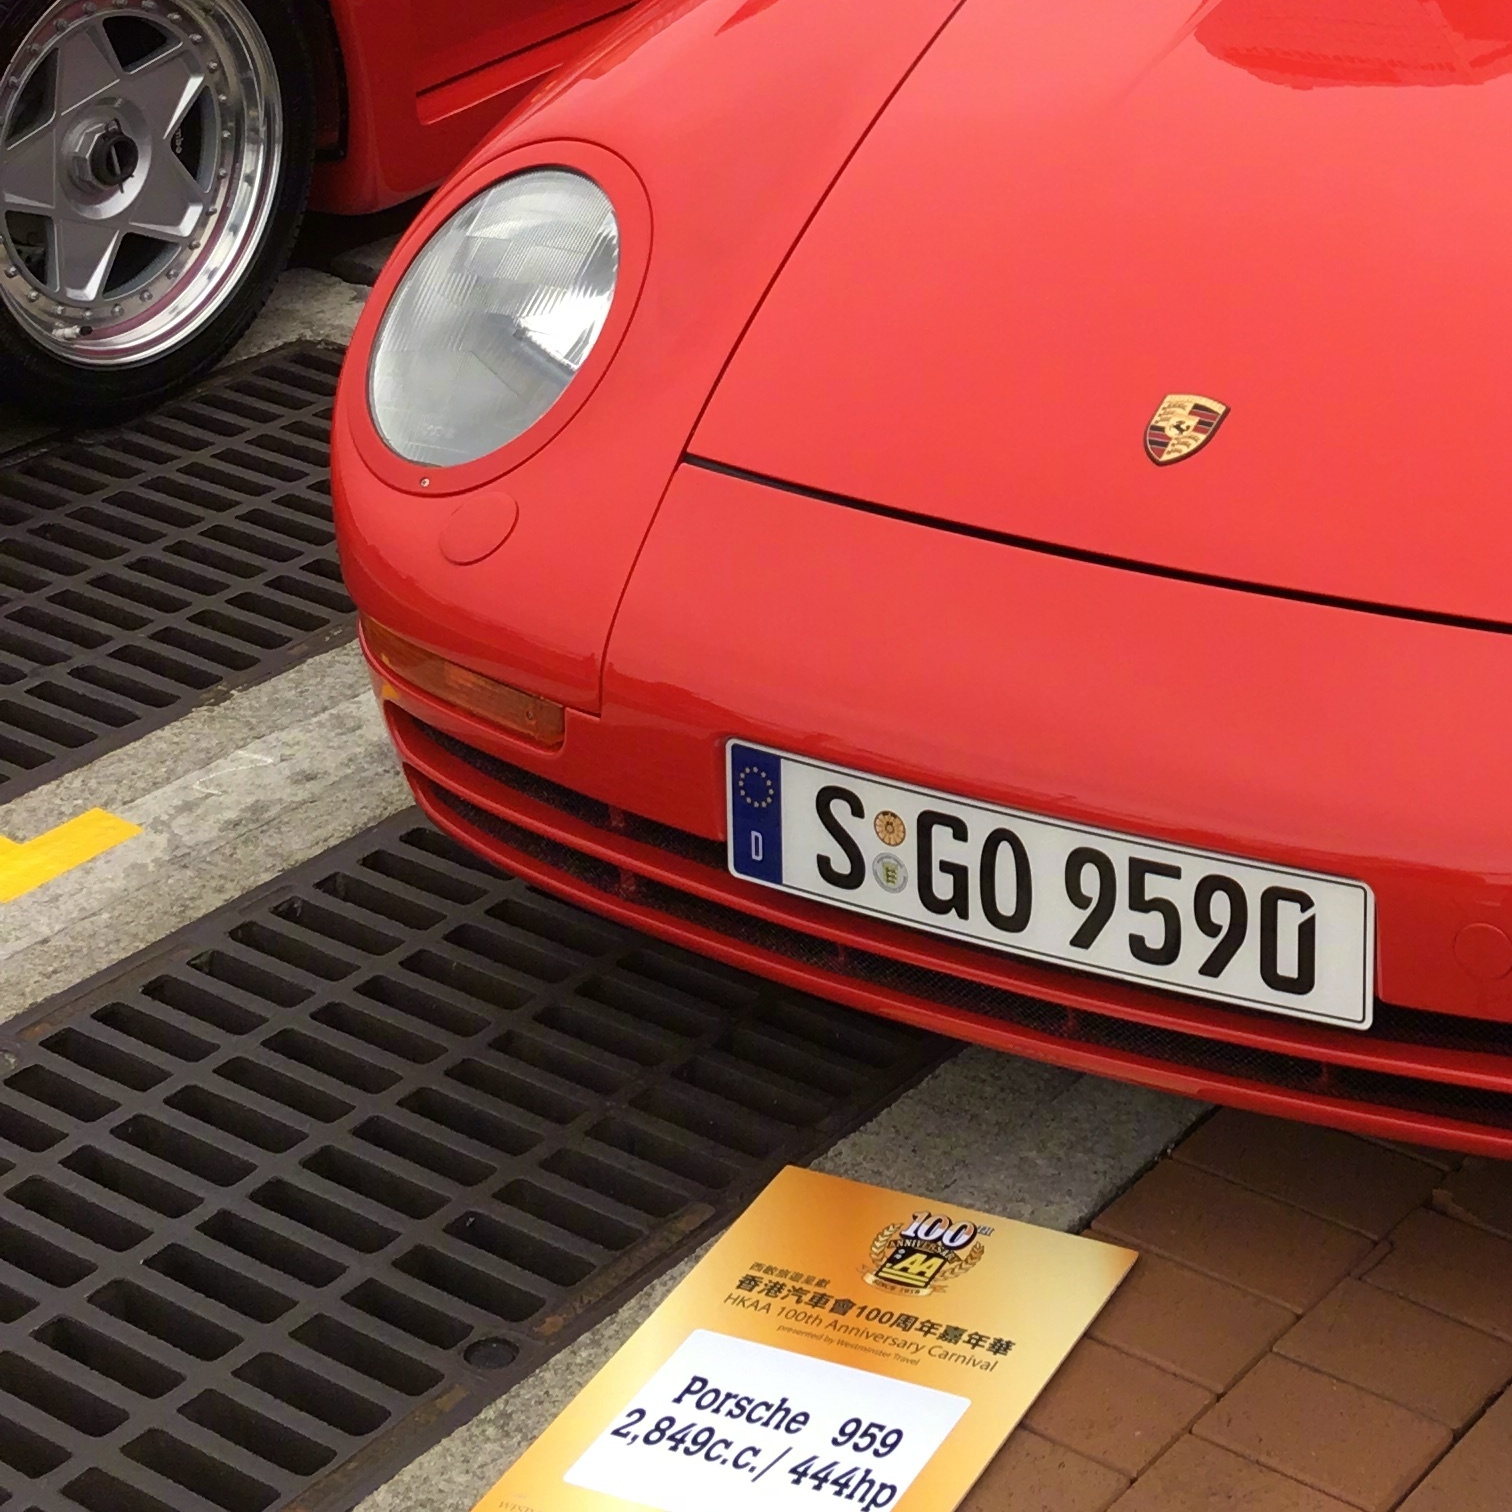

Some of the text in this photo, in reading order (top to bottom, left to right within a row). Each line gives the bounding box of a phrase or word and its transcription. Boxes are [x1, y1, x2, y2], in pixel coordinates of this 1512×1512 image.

[750, 830, 764, 862] D
[814, 785, 1316, 996] S GO 9590
[723, 1292, 999, 1373] HKAA 100th Anniversary Carnival
[735, 1273, 1016, 1357] 香港汽車會100周年嘉年華
[893, 1352, 921, 1367] Travel
[672, 1375, 904, 1458] Porsche 959
[787, 1454, 898, 1512] 444hp
